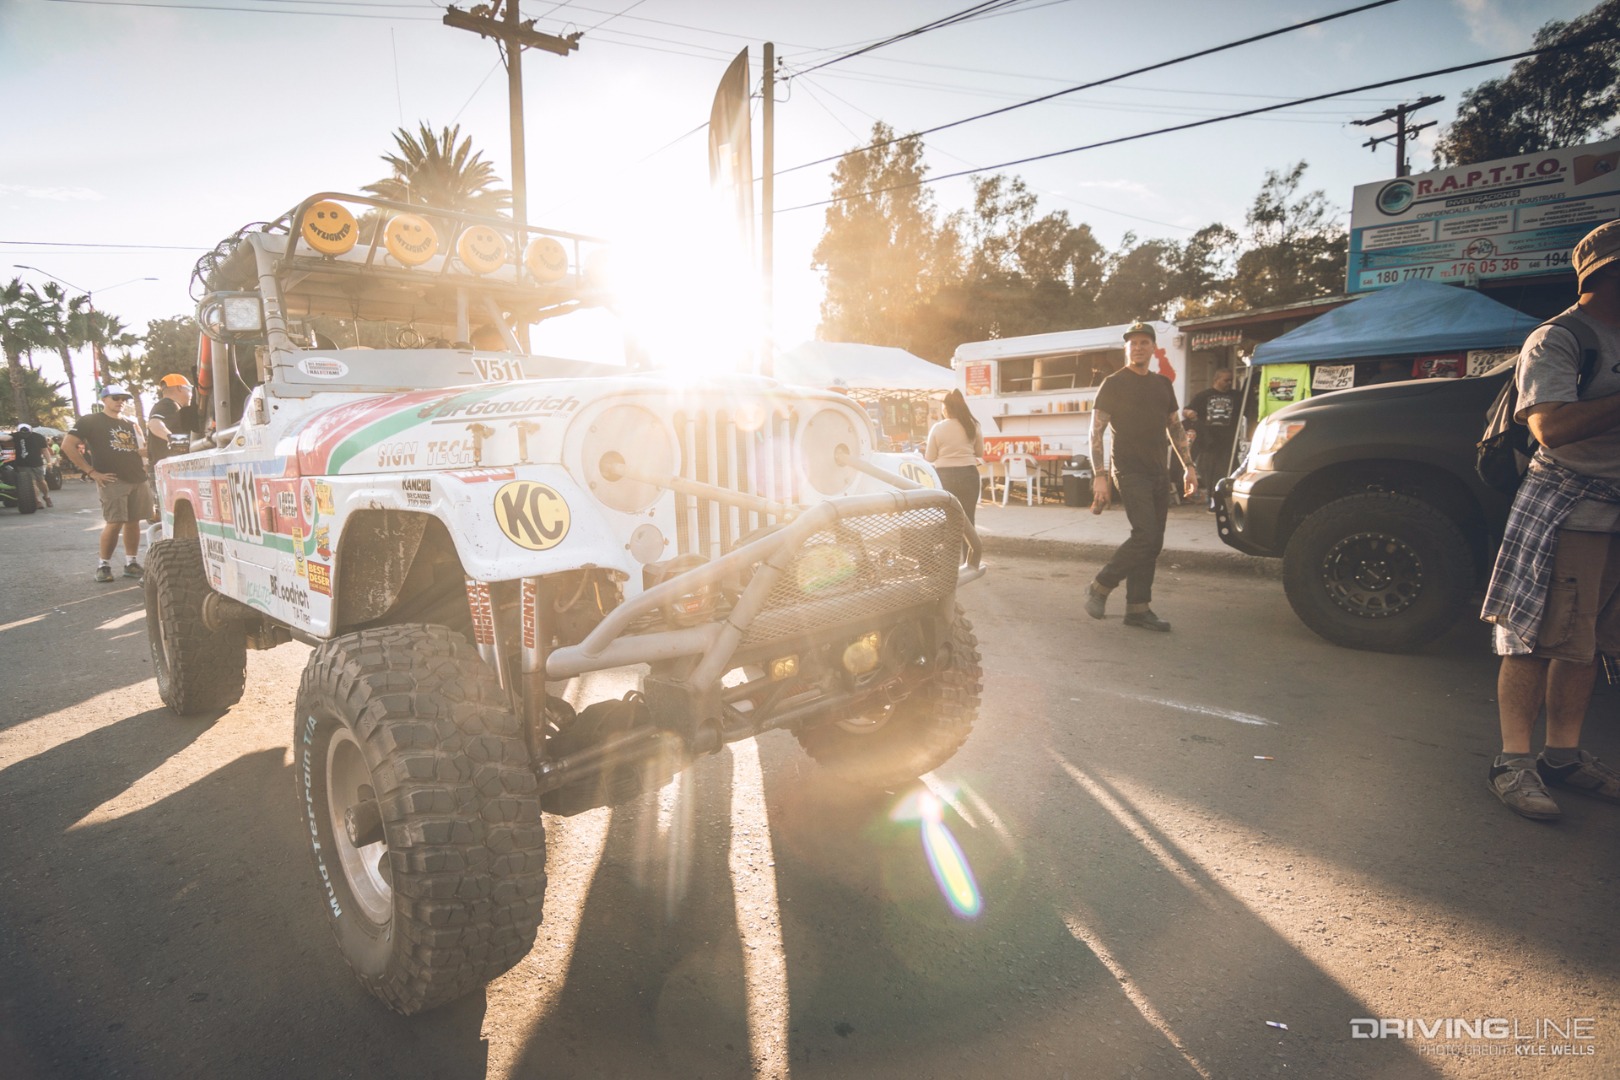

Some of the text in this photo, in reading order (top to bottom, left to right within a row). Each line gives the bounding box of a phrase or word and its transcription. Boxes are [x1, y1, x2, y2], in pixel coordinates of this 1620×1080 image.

[1417, 158, 1567, 195] R.A.P.T.T.O.
[1451, 261, 1475, 276] 176
[1480, 260, 1497, 273] 05
[1501, 257, 1519, 271] 36
[1544, 251, 1569, 266] 194
[1377, 270, 1398, 283] 180
[1403, 266, 1435, 280] 7777
[474, 359, 524, 381] V511
[377, 439, 475, 467] SIGN TECH
[500, 484, 565, 547] KC
[308, 563, 325, 576] BEST
[309, 573, 330, 586] DESER
[523, 582, 537, 649] RANCHO
[304, 714, 318, 746] T/A
